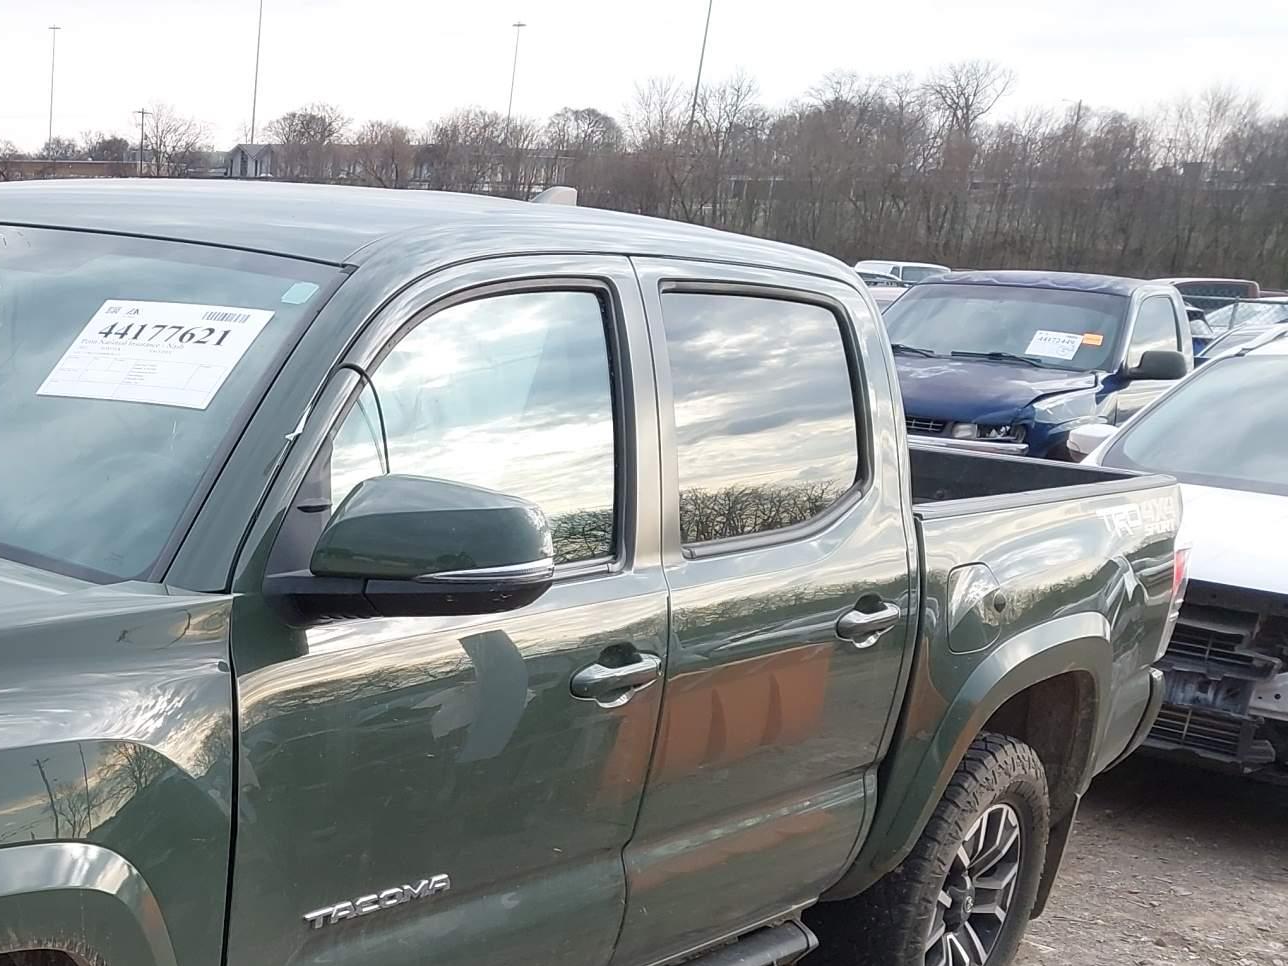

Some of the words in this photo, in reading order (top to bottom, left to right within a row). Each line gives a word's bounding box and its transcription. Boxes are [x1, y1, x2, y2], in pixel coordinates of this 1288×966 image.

[98, 322, 233, 346] 44177621
[1096, 503, 1143, 537] TRD
[1144, 519, 1176, 537] SPORT
[303, 873, 451, 929] TACOMA
